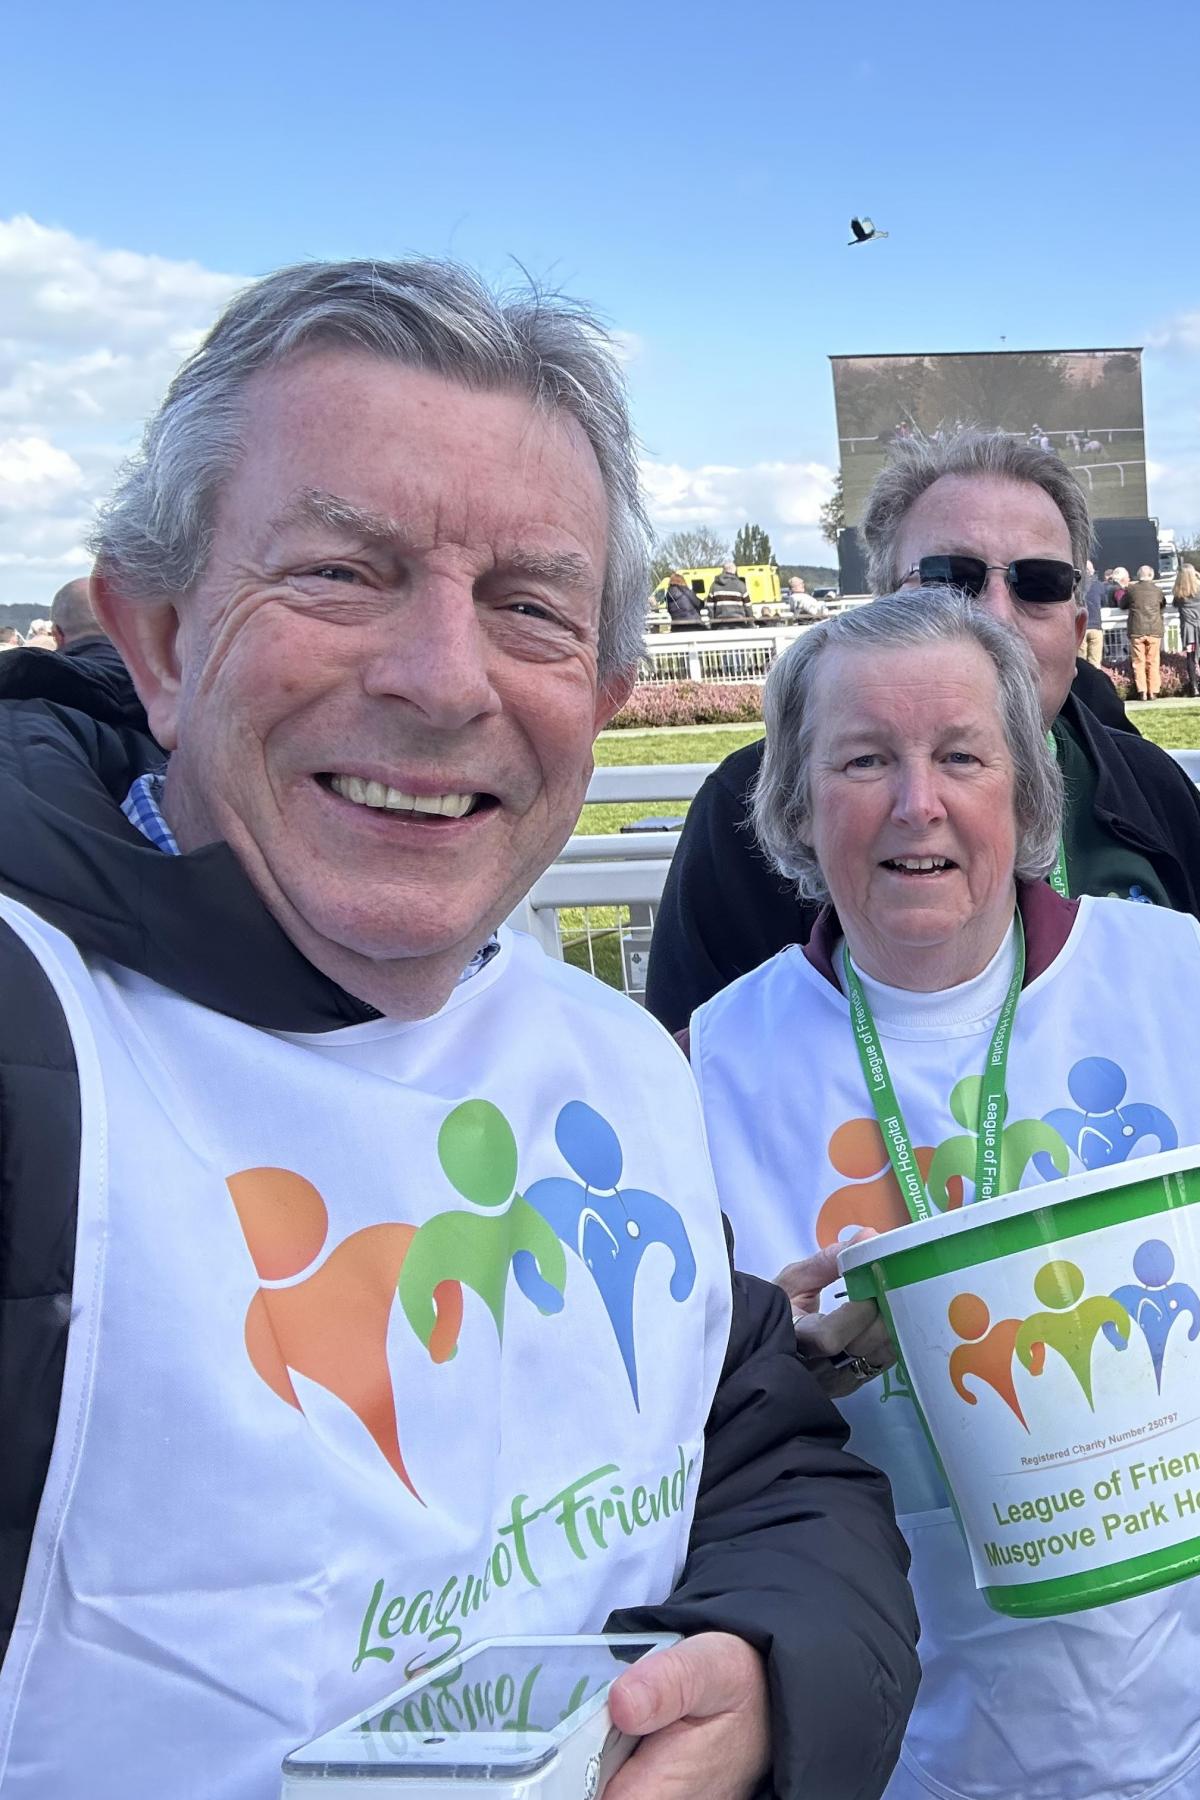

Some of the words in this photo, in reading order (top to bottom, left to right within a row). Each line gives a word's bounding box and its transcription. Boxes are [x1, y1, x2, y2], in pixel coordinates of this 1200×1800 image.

[858, 1031, 873, 1044] of
[991, 1018, 1011, 1067] Hospital
[866, 1044, 886, 1092] League
[884, 1115, 913, 1172] Hospital
[983, 1094, 1001, 1146] League
[984, 1149, 998, 1164] of
[905, 1173, 929, 1221] aunton
[982, 1167, 997, 1199] Frie
[1020, 1448, 1070, 1466] Registered
[1072, 1436, 1107, 1455] Charity
[1109, 1425, 1146, 1444] Number
[1147, 1412, 1178, 1431] 250797
[992, 1487, 1086, 1526] League
[1093, 1471, 1121, 1501] of
[491, 1494, 545, 1588] of
[984, 1526, 1096, 1568] Musgrove
[1102, 1501, 1170, 1541] Park
